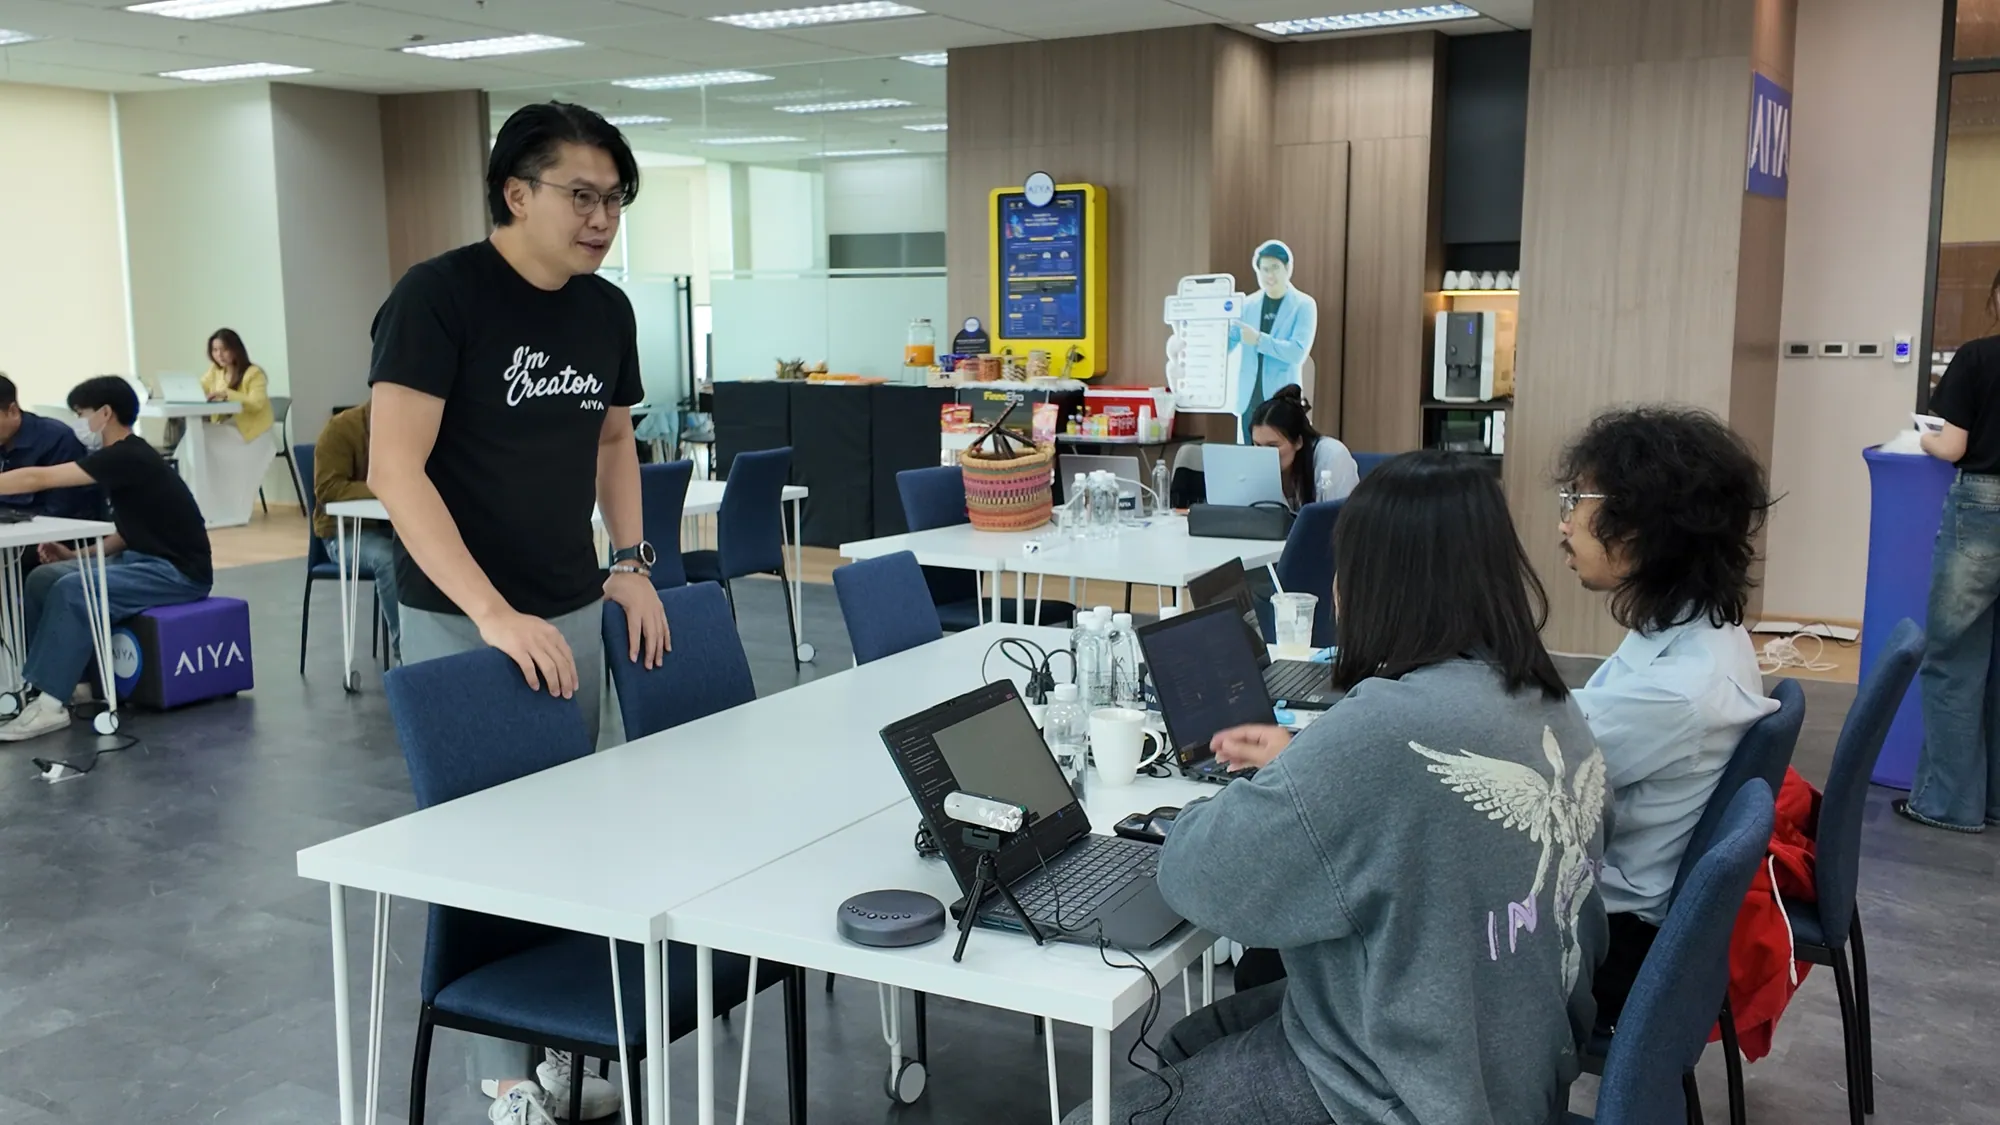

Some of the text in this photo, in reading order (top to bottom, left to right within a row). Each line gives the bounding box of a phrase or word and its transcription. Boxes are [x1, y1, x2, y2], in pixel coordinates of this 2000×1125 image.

[503, 346, 551, 381] I'm
[506, 365, 603, 407] Creator
[580, 399, 605, 411] AIYA
[174, 641, 245, 677] AIYA
